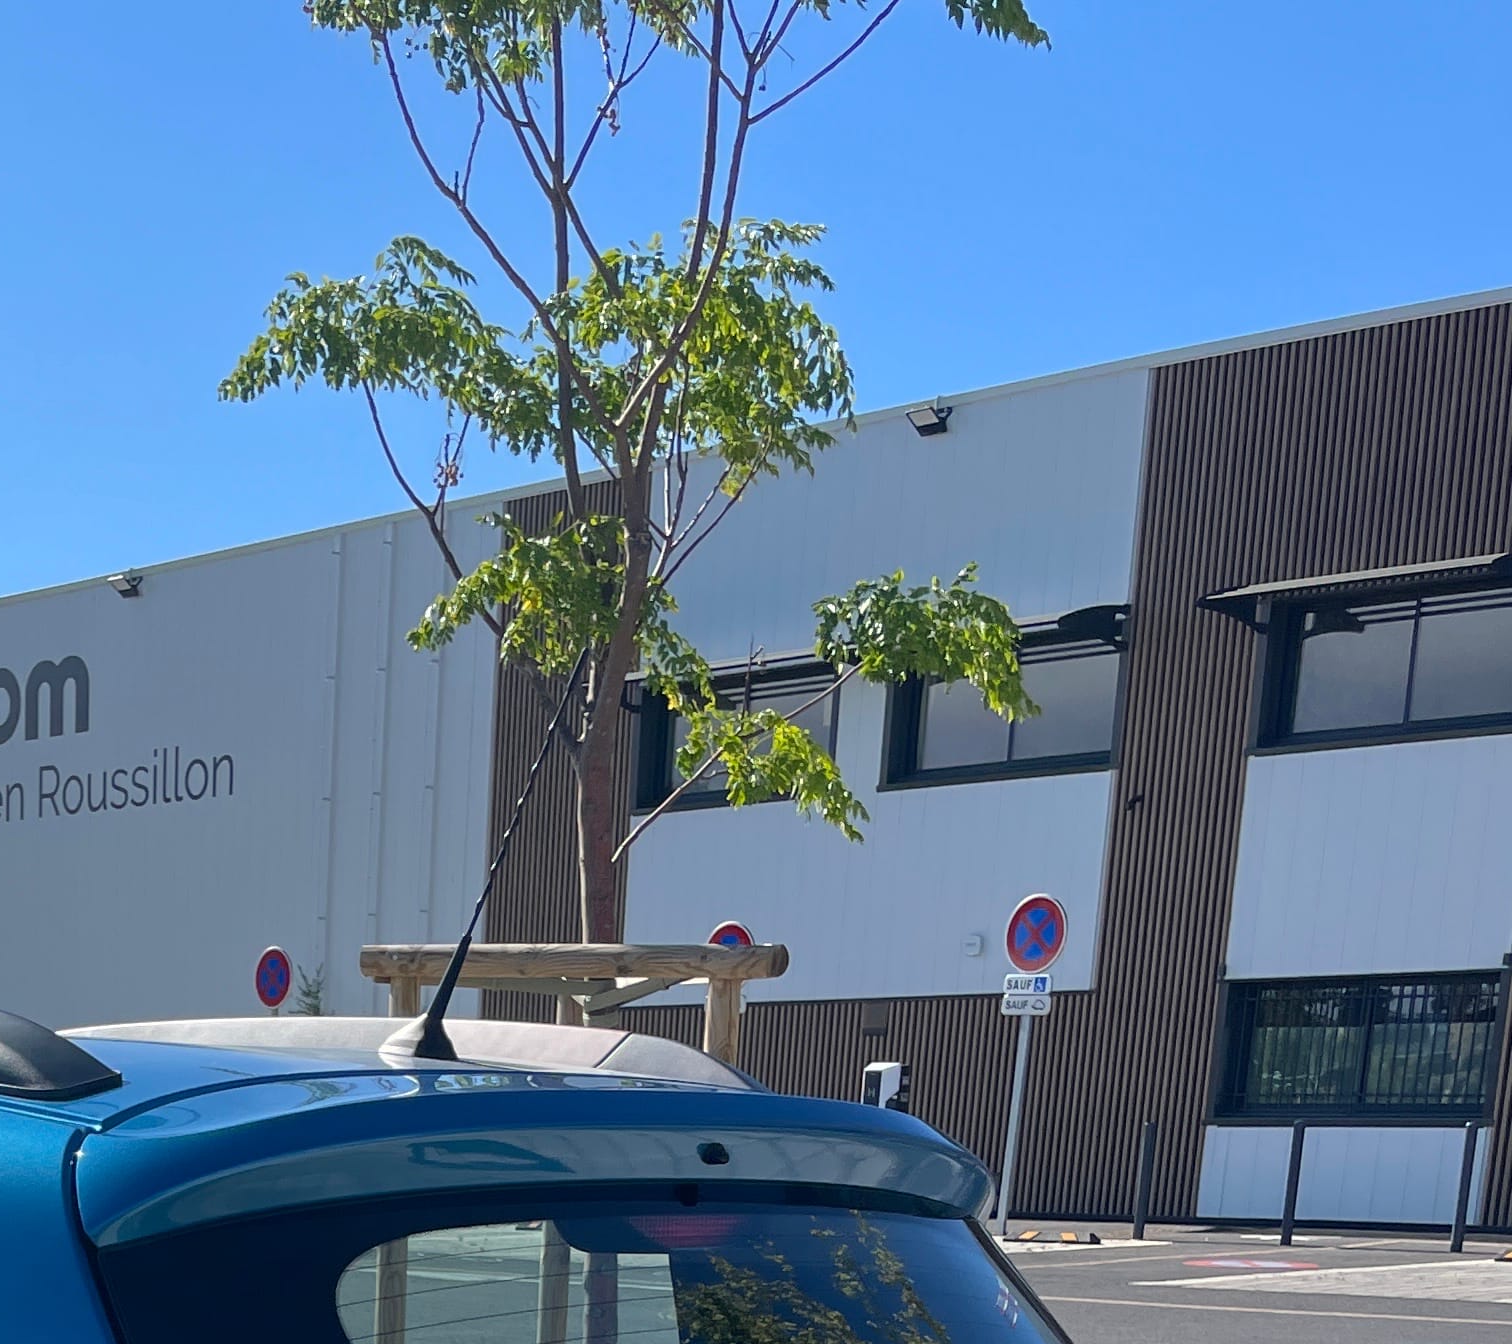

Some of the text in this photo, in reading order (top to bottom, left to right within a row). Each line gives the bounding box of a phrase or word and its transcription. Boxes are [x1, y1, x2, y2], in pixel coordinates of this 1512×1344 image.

[38, 746, 234, 818] Roussillon
[1006, 979, 1033, 991] SAUF
[1005, 1000, 1029, 1010] SAUF
